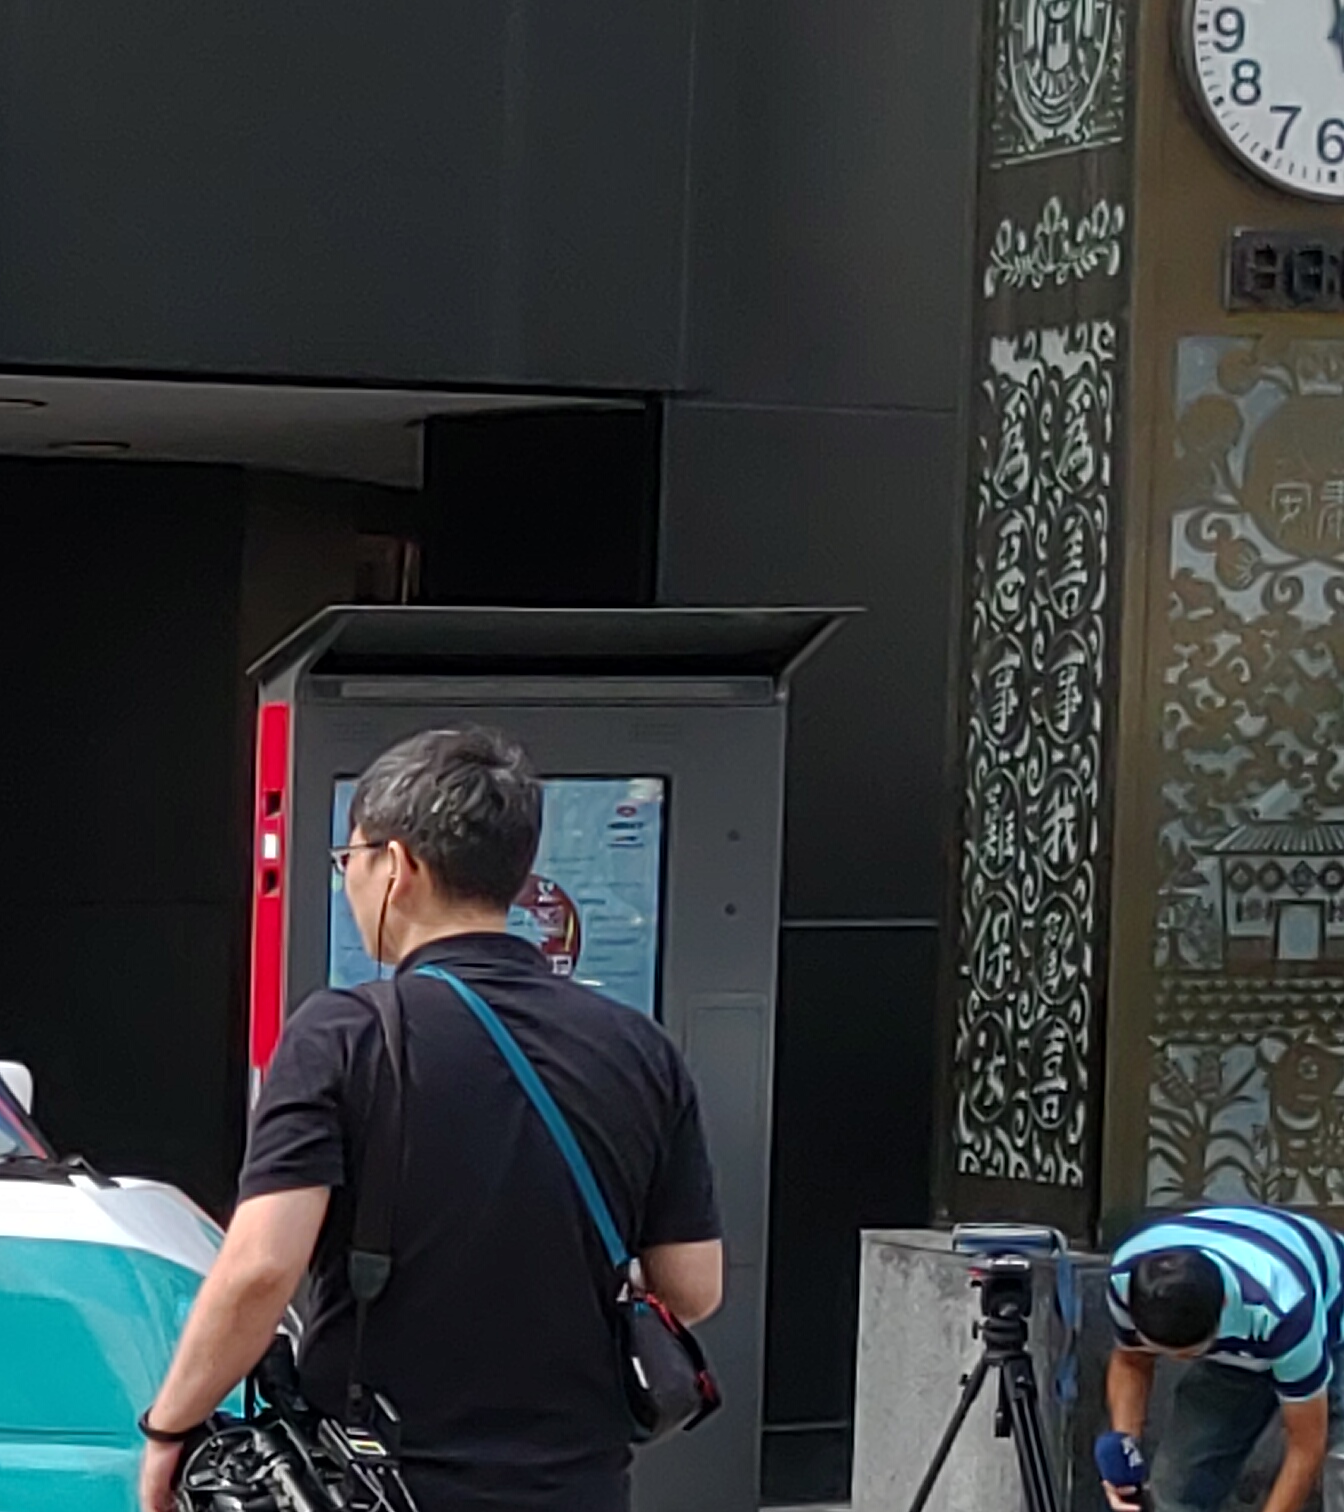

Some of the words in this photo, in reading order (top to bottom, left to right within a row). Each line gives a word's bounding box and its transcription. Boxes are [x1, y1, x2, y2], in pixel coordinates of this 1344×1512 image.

[1212, 7, 1246, 53] 9
[1230, 59, 1262, 105] 8
[1270, 105, 1302, 150] 7
[1316, 118, 1344, 164] 6
